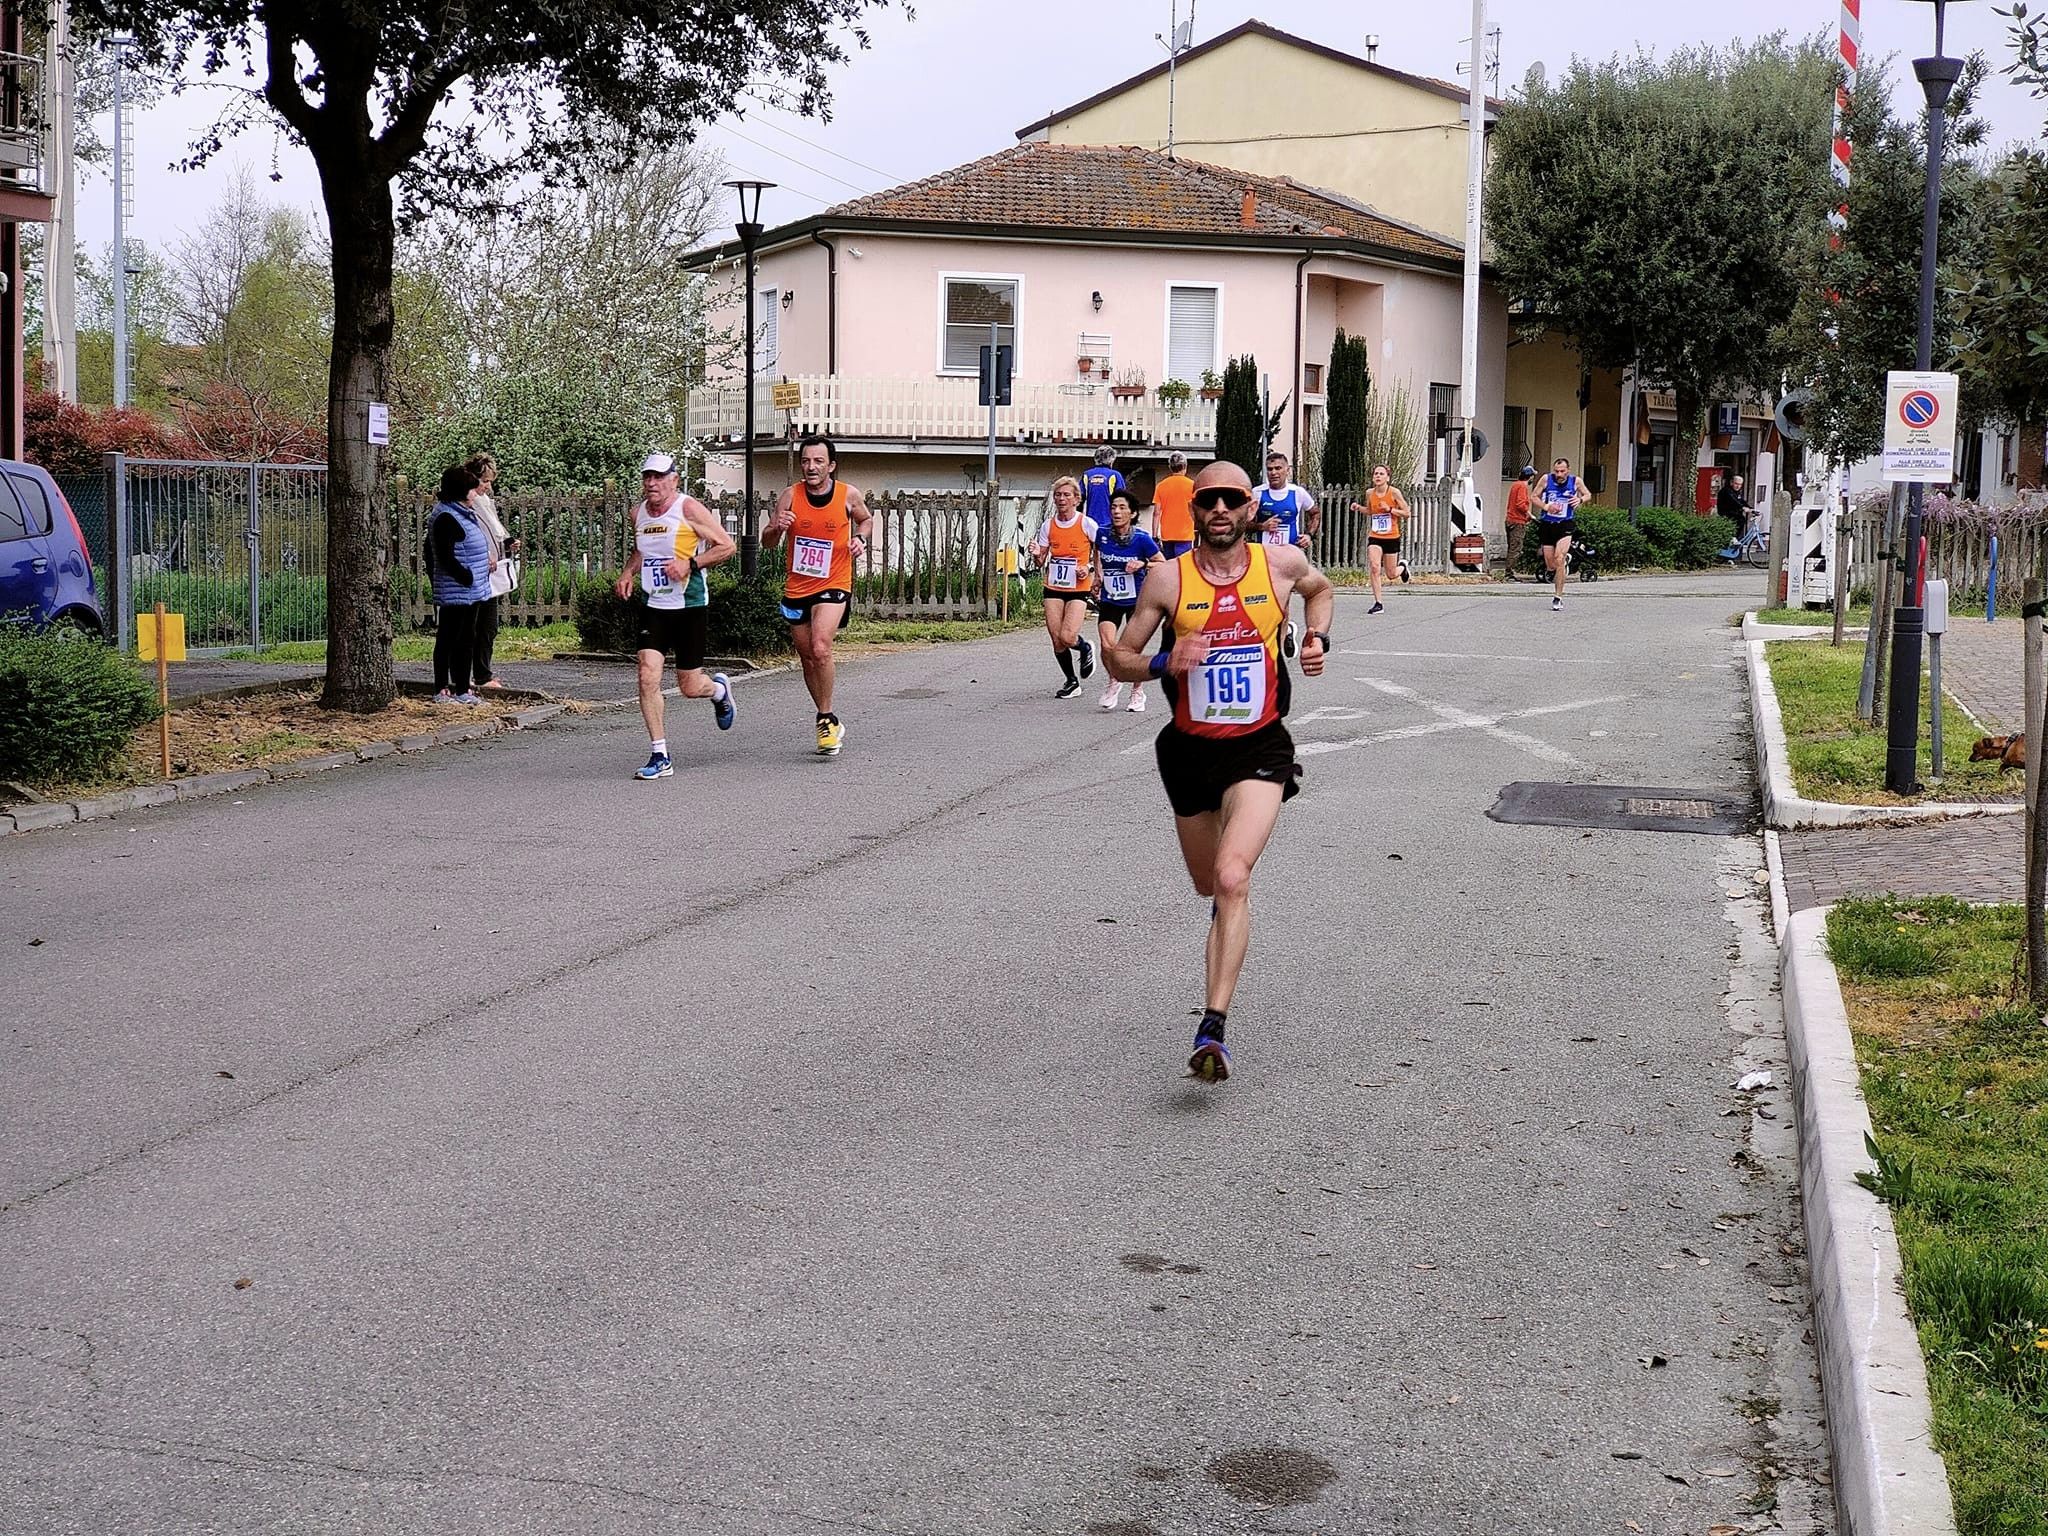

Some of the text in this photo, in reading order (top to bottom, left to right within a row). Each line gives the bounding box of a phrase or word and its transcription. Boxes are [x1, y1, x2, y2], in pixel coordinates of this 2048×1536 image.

[1269, 531, 1284, 545] 251
[801, 547, 824, 567] 264
[1057, 565, 1069, 580] 87
[1112, 576, 1126, 592] 49
[1203, 622, 1259, 641] TLETICA
[1205, 667, 1250, 703] 195
